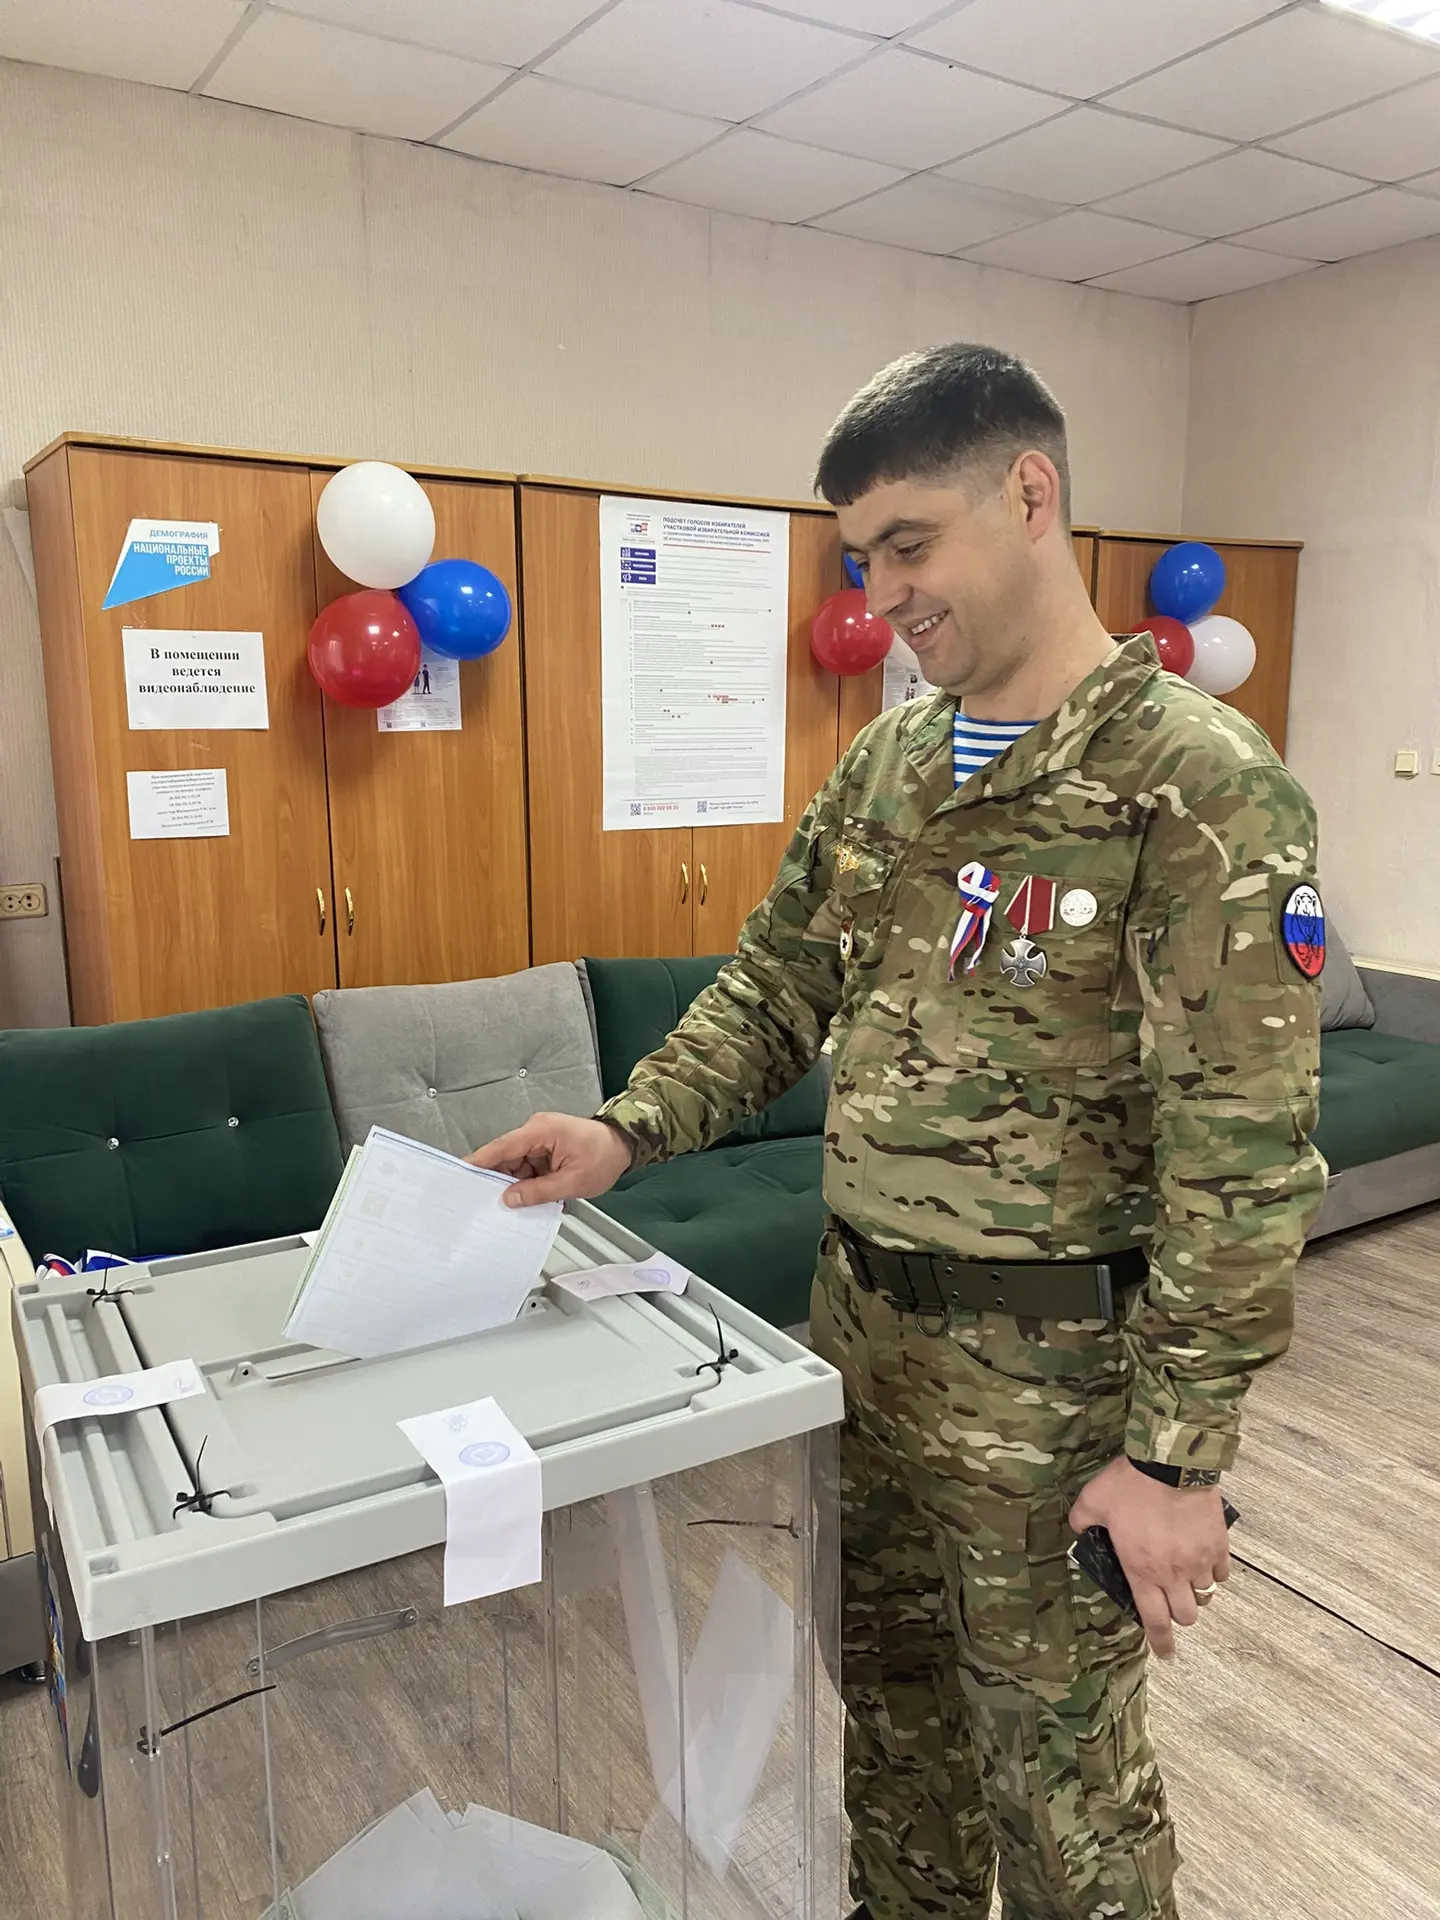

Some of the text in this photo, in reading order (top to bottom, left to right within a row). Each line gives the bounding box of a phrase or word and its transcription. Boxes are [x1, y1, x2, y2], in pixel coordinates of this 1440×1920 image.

[149, 529, 208, 539] ДЕМОГРАФИЯ
[698, 527, 739, 535] ИЗБИРАТЕЛЬНОЙ
[133, 543, 207, 556] НАЦИОНАЛЬНЫЕ
[166, 554, 208, 565] ПРОЕКТЫ
[174, 566, 209, 576] РОССИИ
[150, 648, 240, 661] В помещении
[172, 667, 221, 677] ведется
[139, 682, 256, 694] видеонаблюдение
